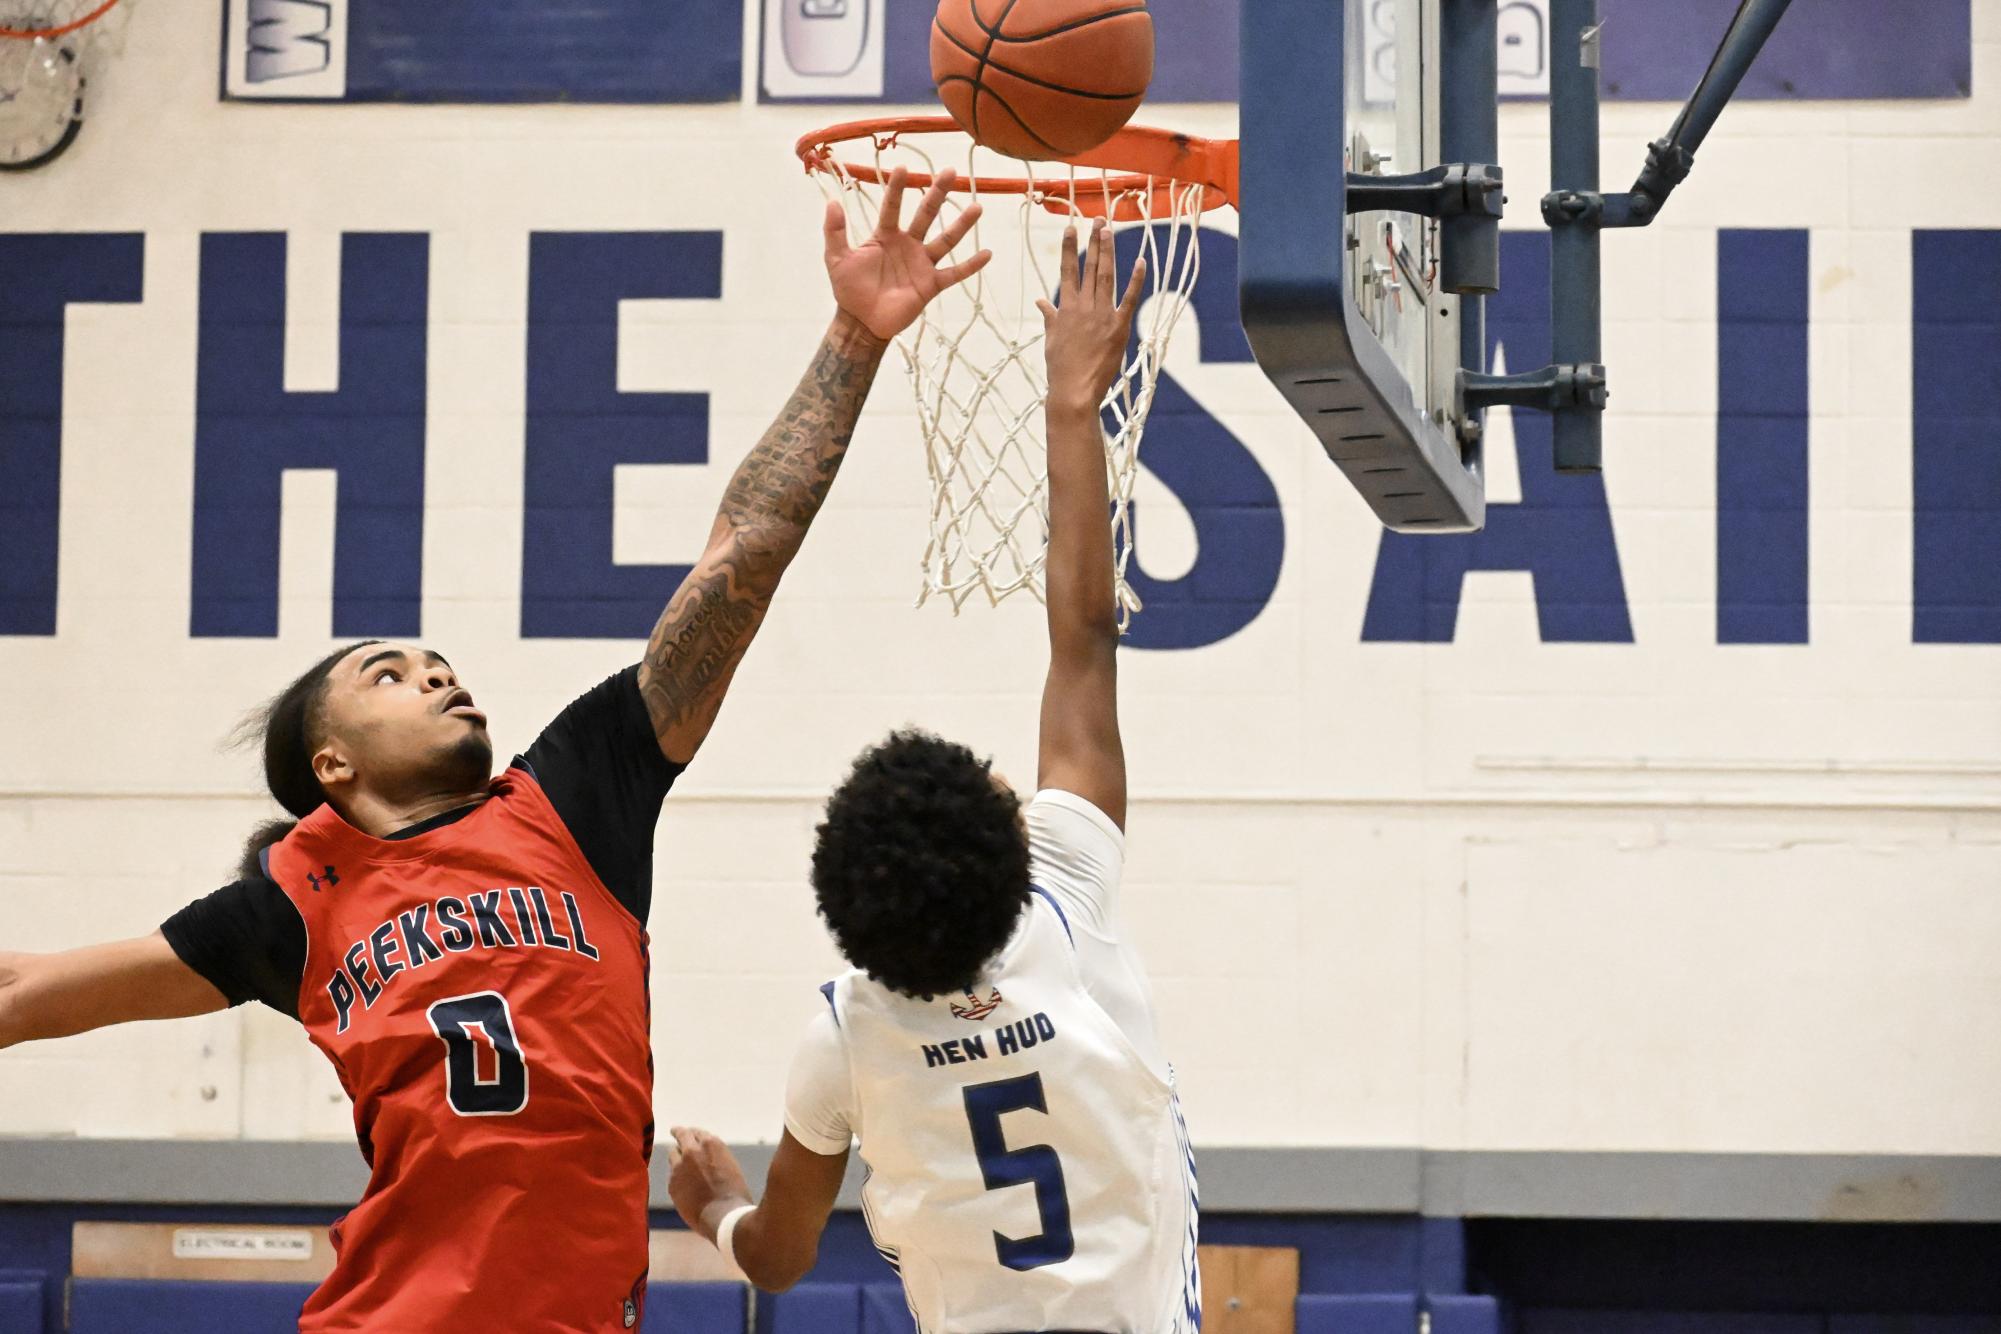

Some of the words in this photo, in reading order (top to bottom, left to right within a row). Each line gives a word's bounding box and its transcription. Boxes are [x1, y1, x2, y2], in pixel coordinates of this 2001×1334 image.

[0, 230, 723, 639] THE
[326, 886, 600, 1036] PEEKSKILL
[425, 990, 529, 1117] 0
[921, 1034, 988, 1068] HEN
[995, 1012, 1056, 1056] HUD
[962, 1071, 1074, 1272] 5
